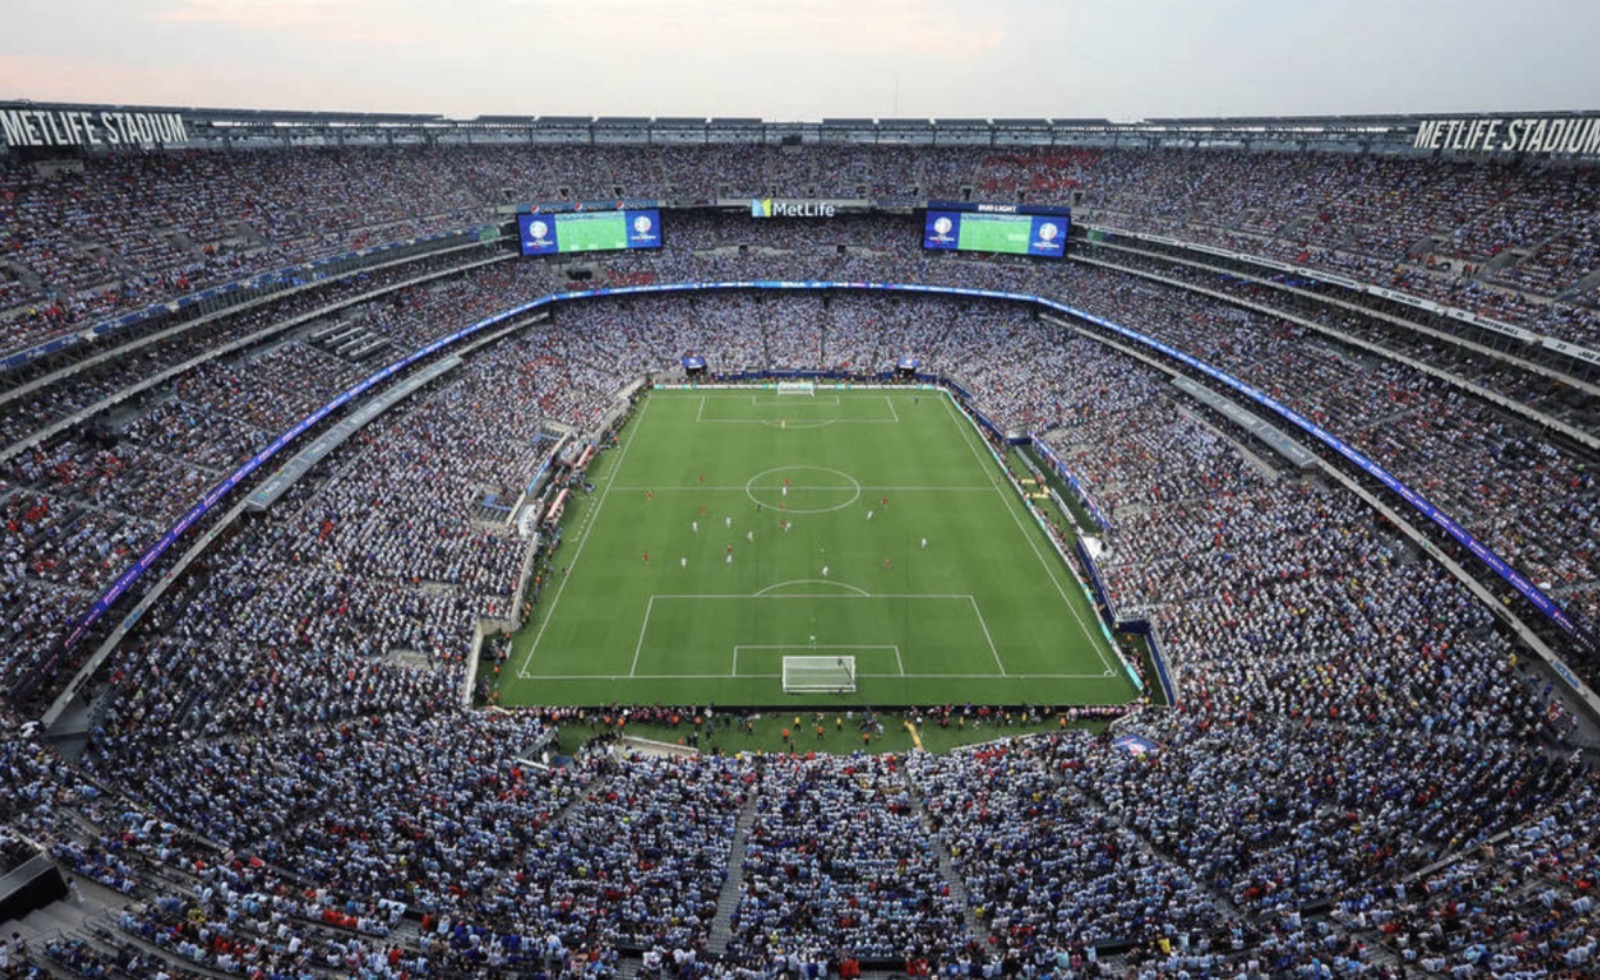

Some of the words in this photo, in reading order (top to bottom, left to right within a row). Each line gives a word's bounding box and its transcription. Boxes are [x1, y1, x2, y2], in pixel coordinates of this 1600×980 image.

[0, 110, 101, 146] METLIFE
[101, 112, 188, 144] STADIUM
[1413, 120, 1502, 149] METLIFE
[773, 202, 835, 217] MetLife
[978, 204, 994, 212] BUD
[995, 204, 1017, 214] LIGHT
